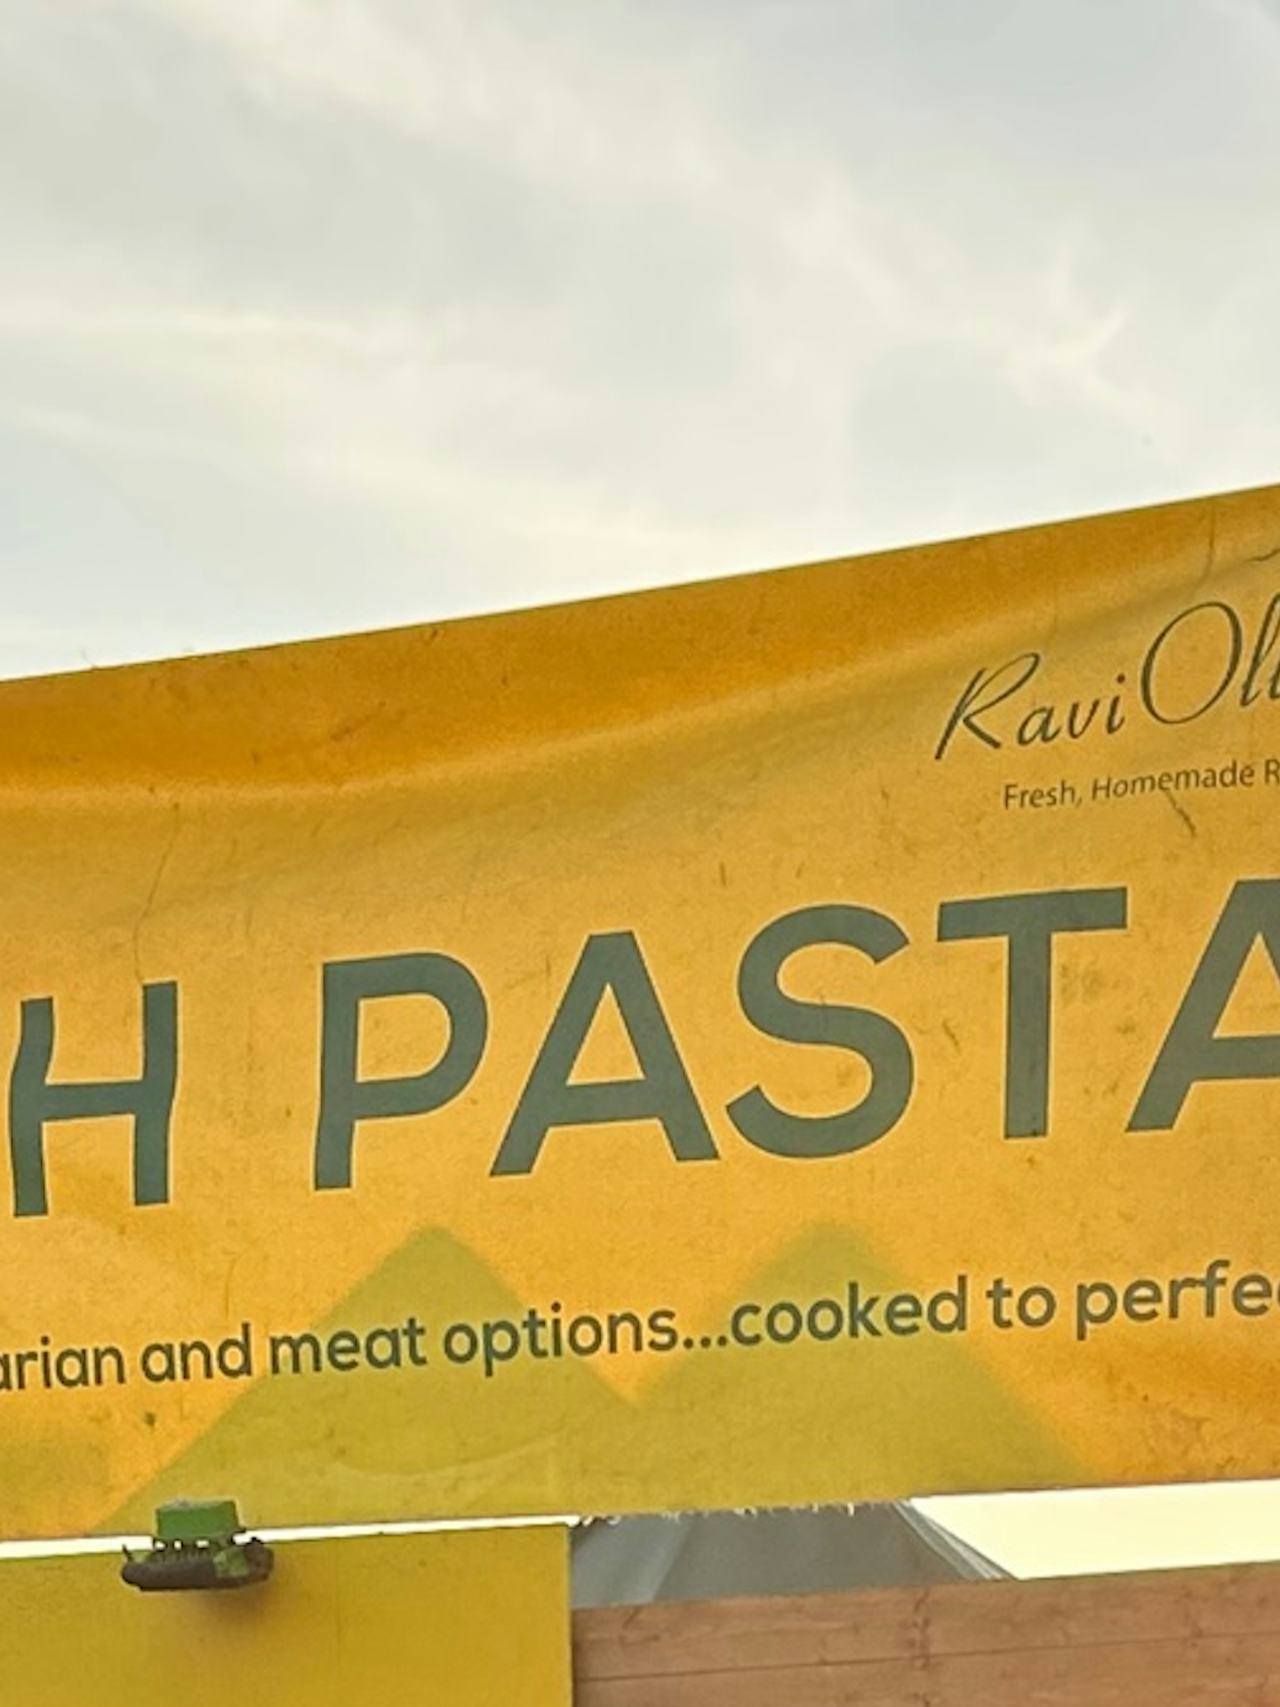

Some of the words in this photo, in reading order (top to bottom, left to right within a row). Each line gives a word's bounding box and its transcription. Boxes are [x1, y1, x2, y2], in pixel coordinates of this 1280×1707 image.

[1003, 781, 1083, 810] Fresh,
[1091, 760, 1255, 800] Homemade
[142, 1322, 252, 1383] and
[270, 1315, 427, 1375] meat
[986, 1276, 1057, 1328] to
